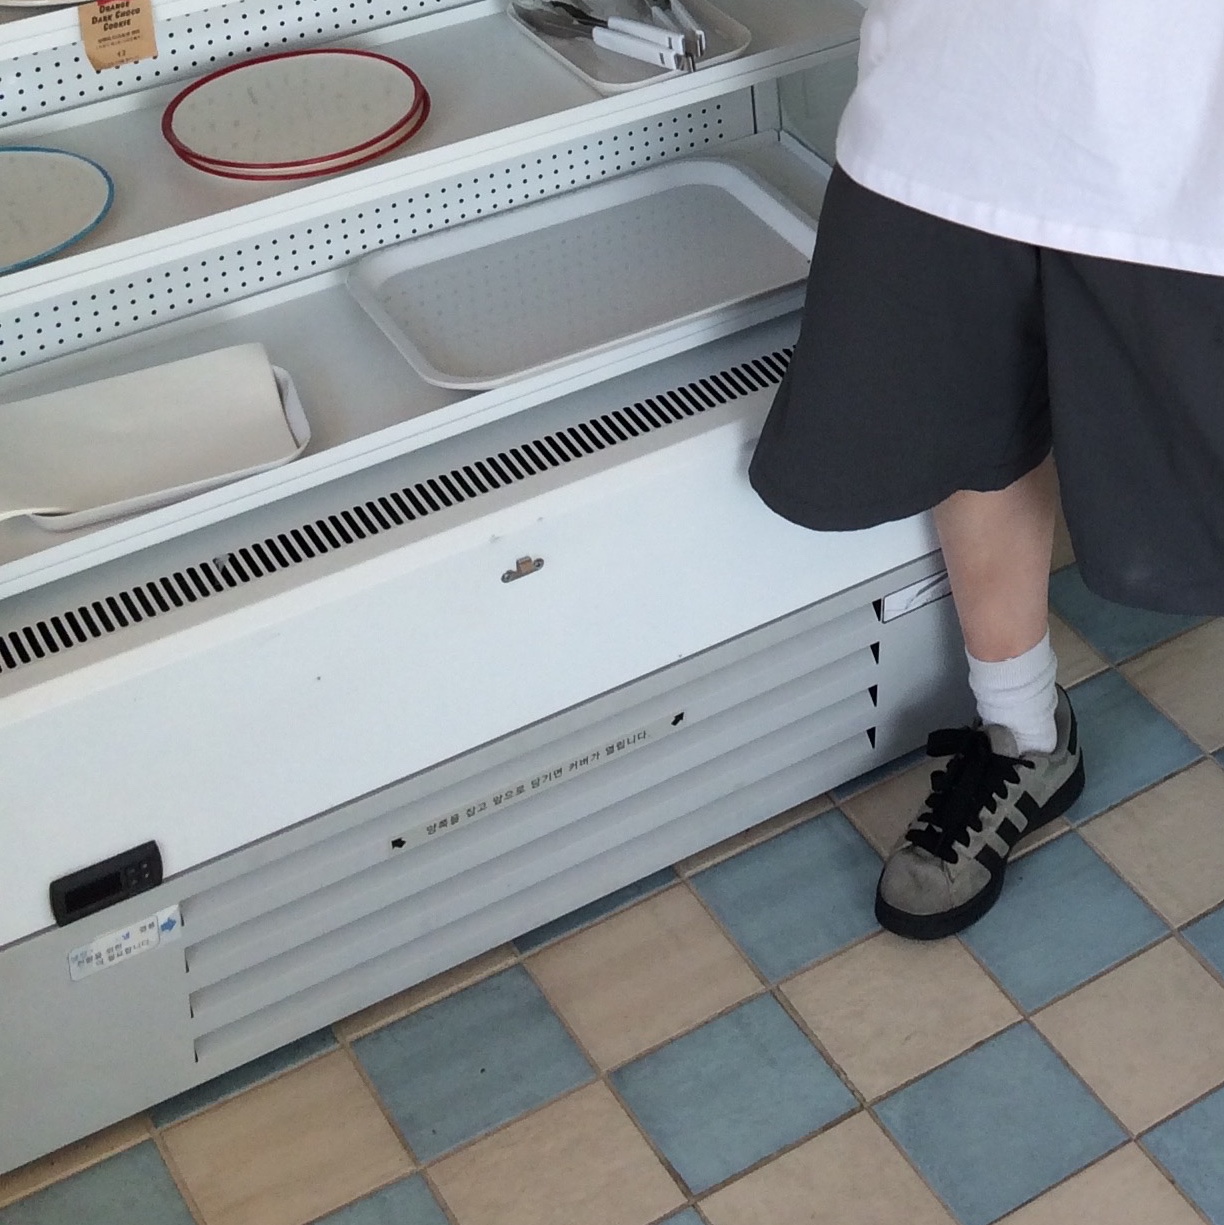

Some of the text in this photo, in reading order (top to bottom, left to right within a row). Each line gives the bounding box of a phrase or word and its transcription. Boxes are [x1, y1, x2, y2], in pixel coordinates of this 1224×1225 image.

[92, 14, 113, 25] DARK
[426, 813, 460, 835] 양쪽을
[465, 801, 487, 818] 잡고
[492, 784, 525, 805] 앞으로
[531, 767, 563, 789] 당기면
[569, 751, 600, 771] 커버가
